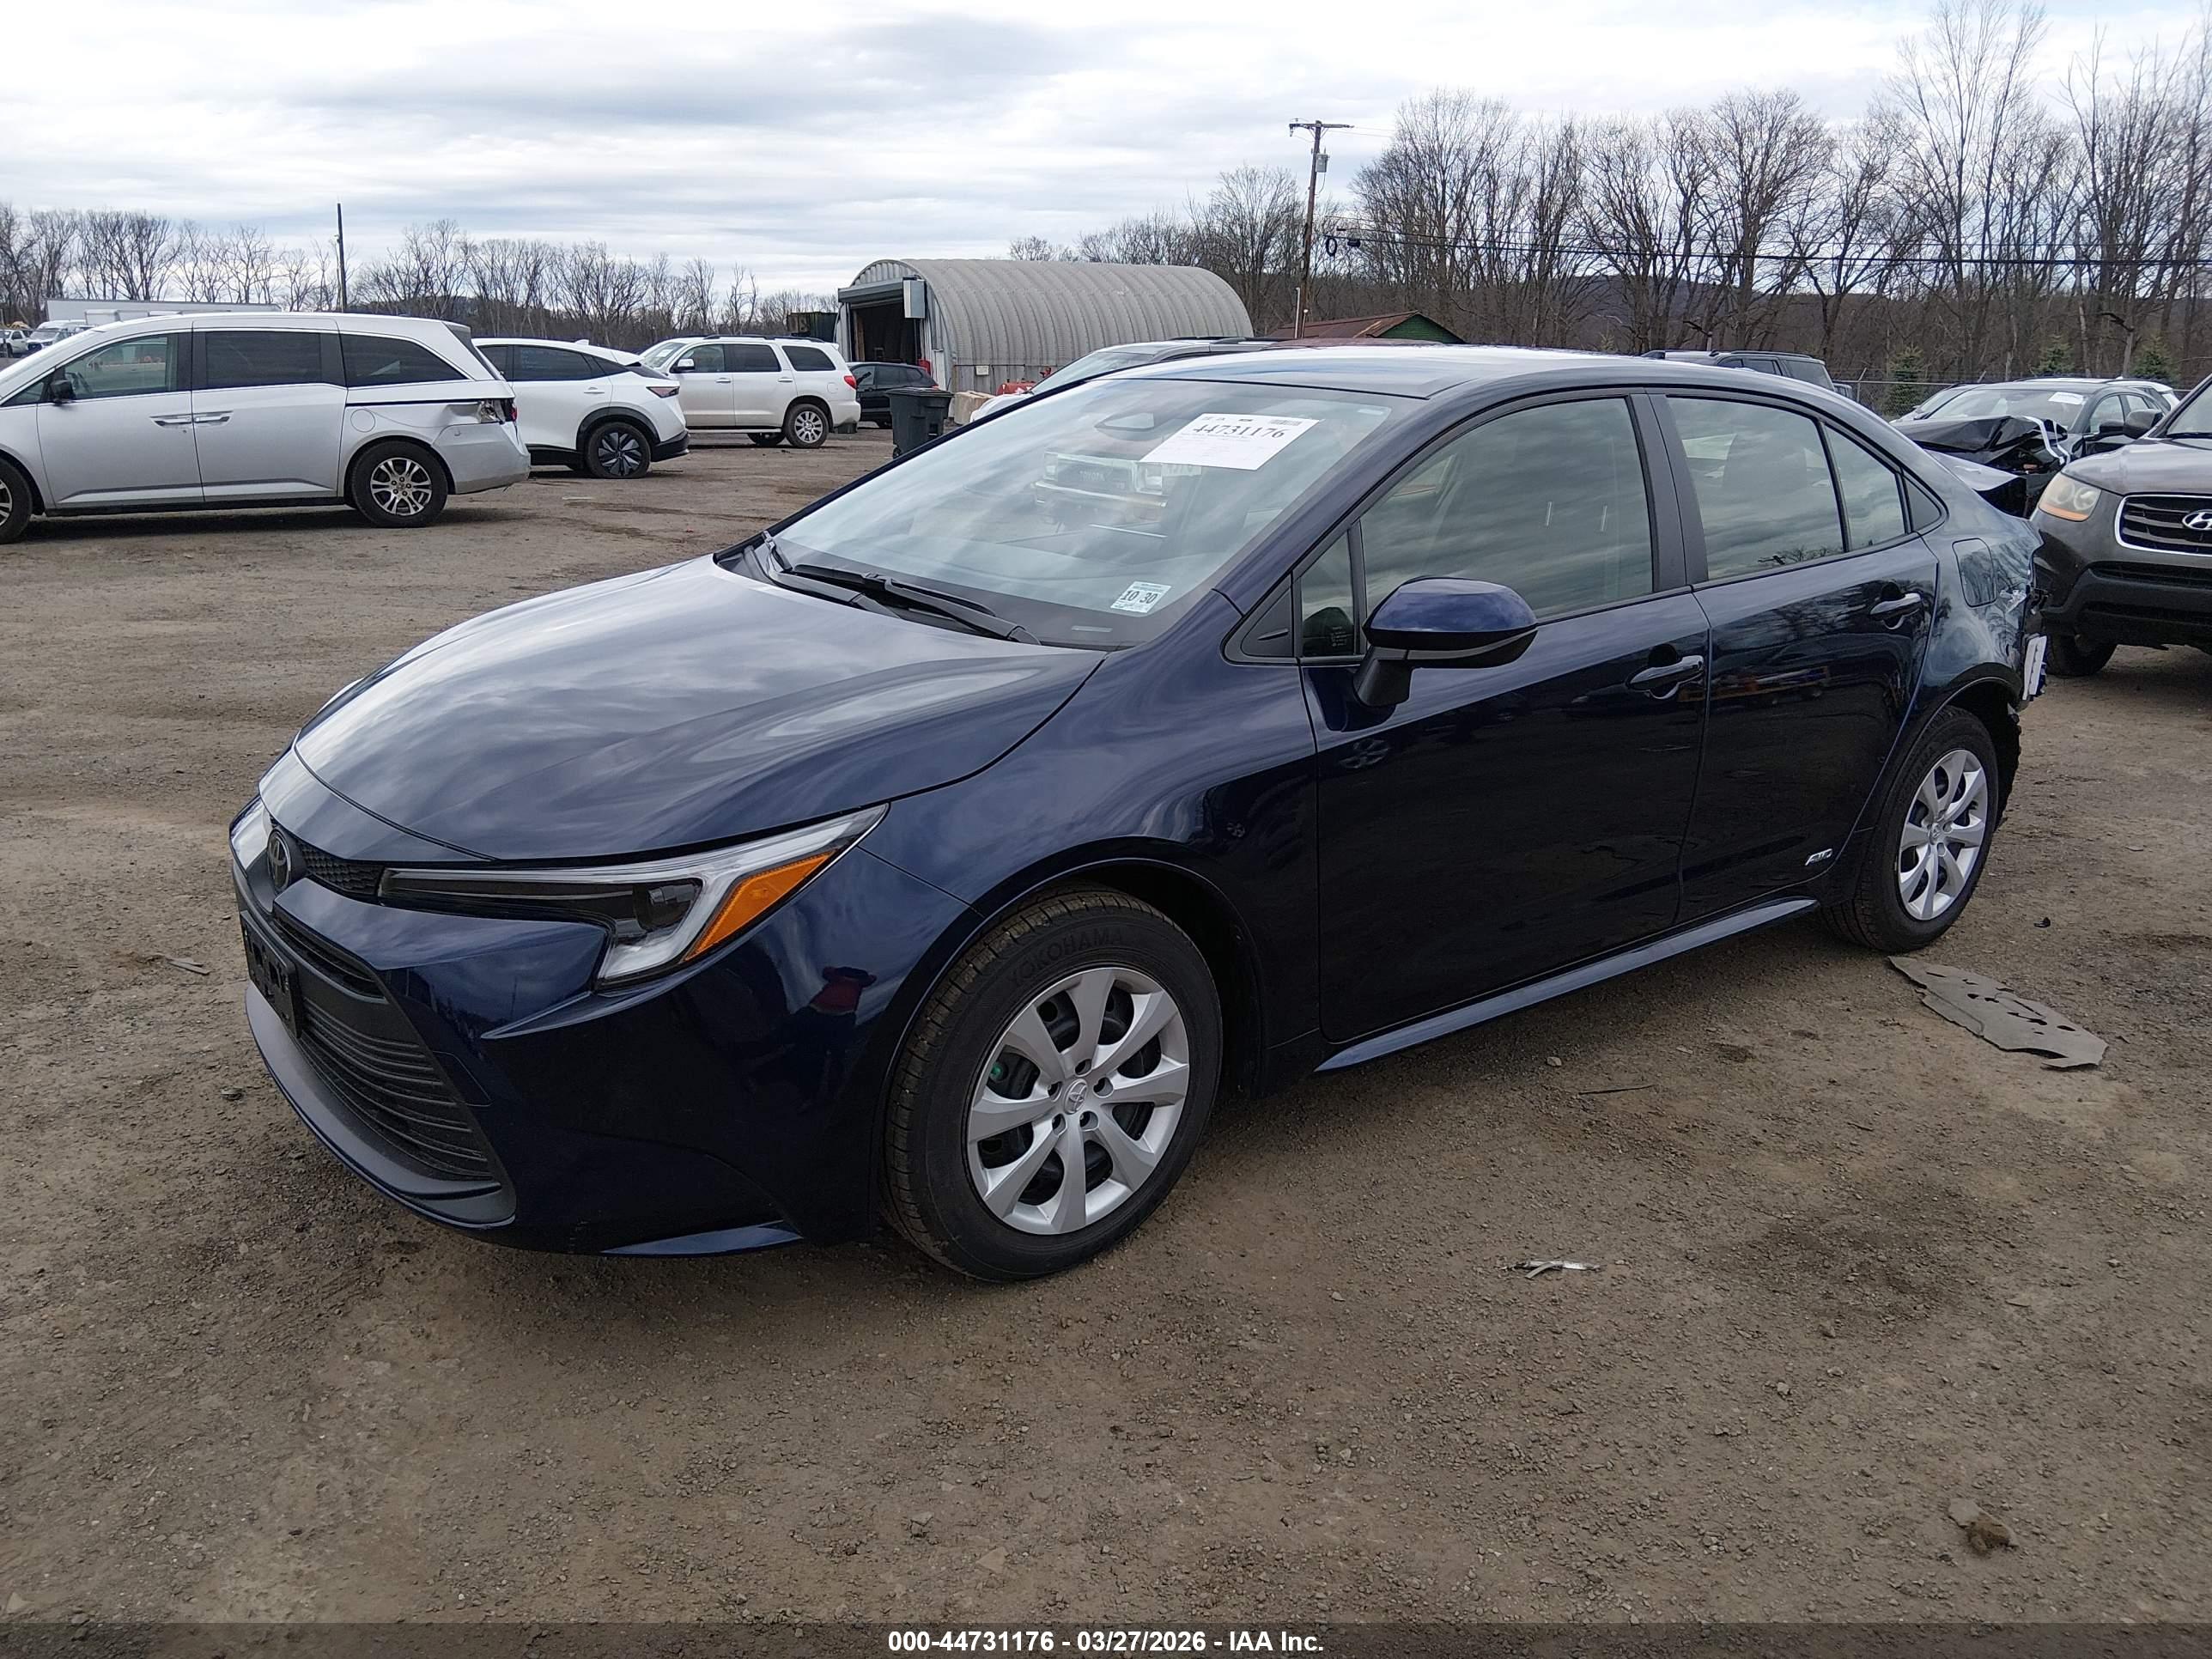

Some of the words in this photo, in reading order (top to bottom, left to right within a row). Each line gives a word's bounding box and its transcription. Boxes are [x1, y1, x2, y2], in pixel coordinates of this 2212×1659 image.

[1193, 424, 1287, 438] 44731176
[1119, 590, 1139, 601] 10
[1139, 592, 1158, 604] 30
